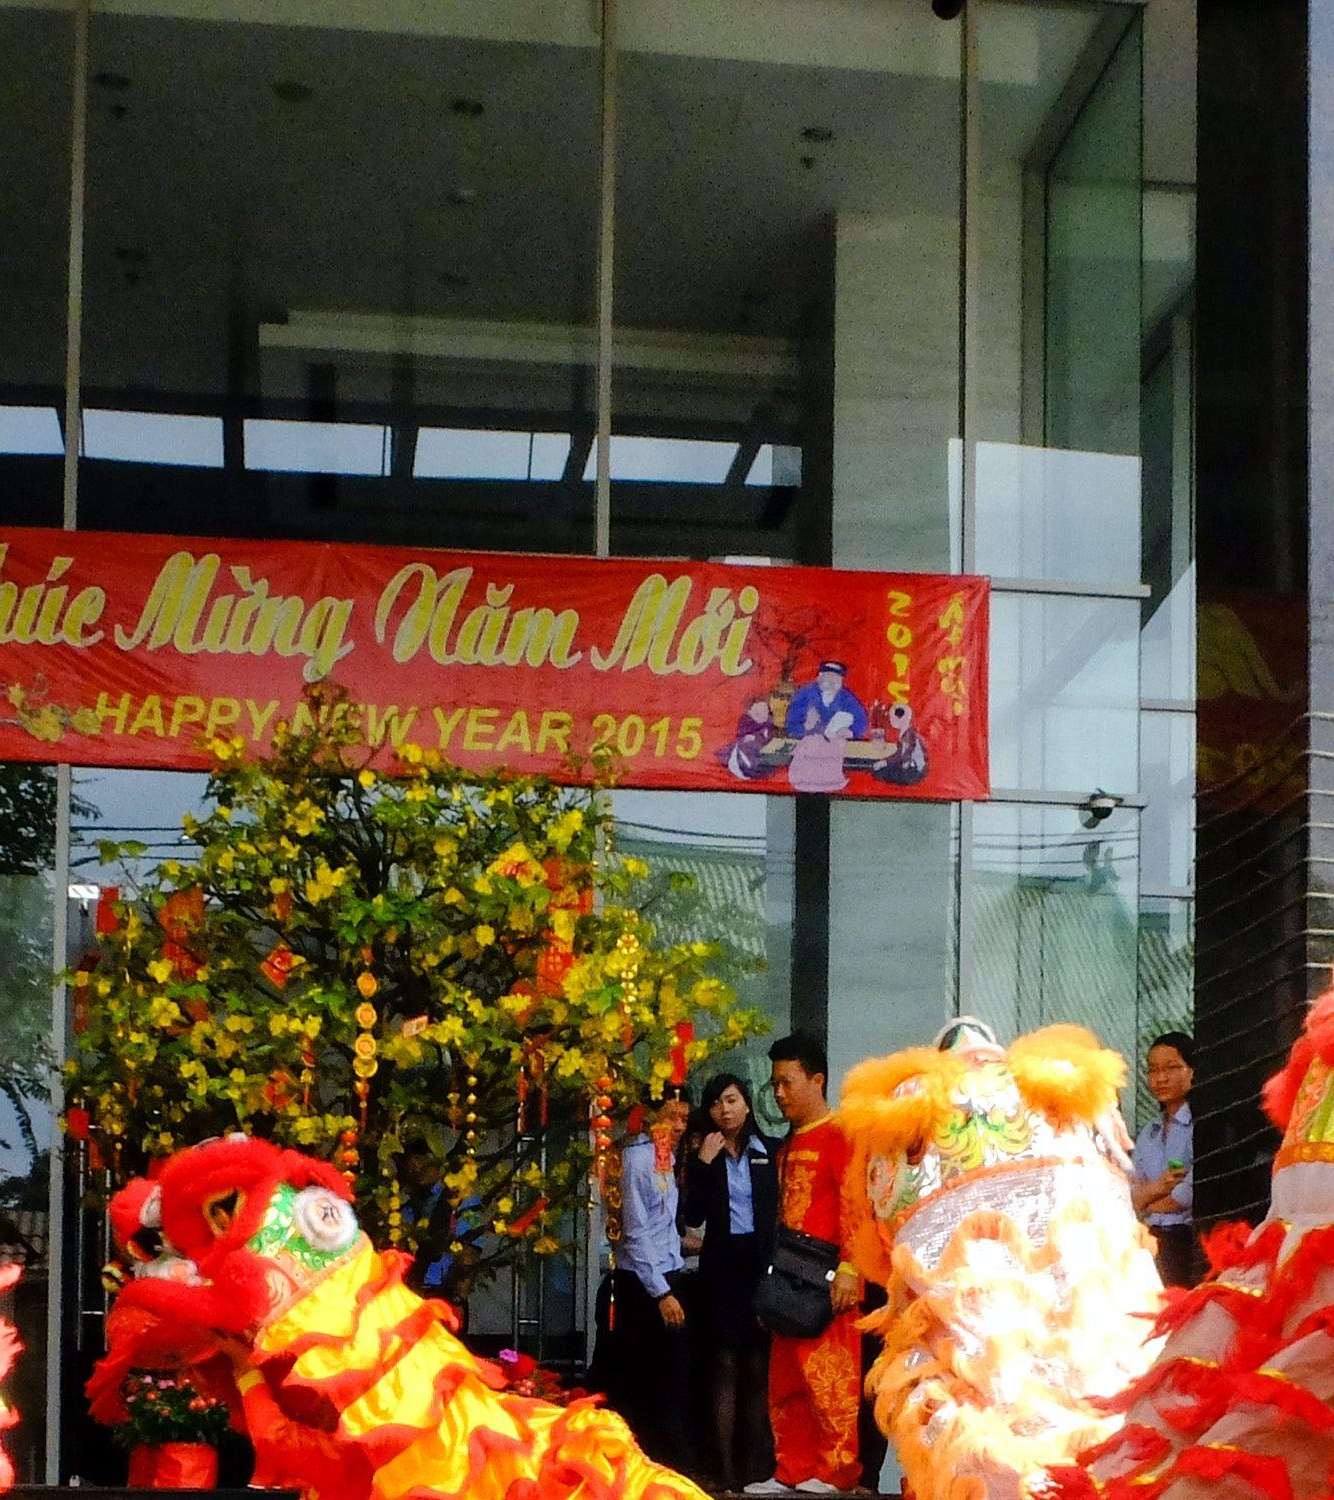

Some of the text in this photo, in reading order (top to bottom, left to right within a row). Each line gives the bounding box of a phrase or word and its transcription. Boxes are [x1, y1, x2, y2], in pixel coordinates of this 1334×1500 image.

[115, 551, 355, 683] Mừng
[376, 562, 583, 667] Năm
[591, 573, 760, 677] Mới
[97, 692, 279, 741] HAPPY
[433, 706, 574, 754] YEAR
[589, 713, 704, 760] 2015
